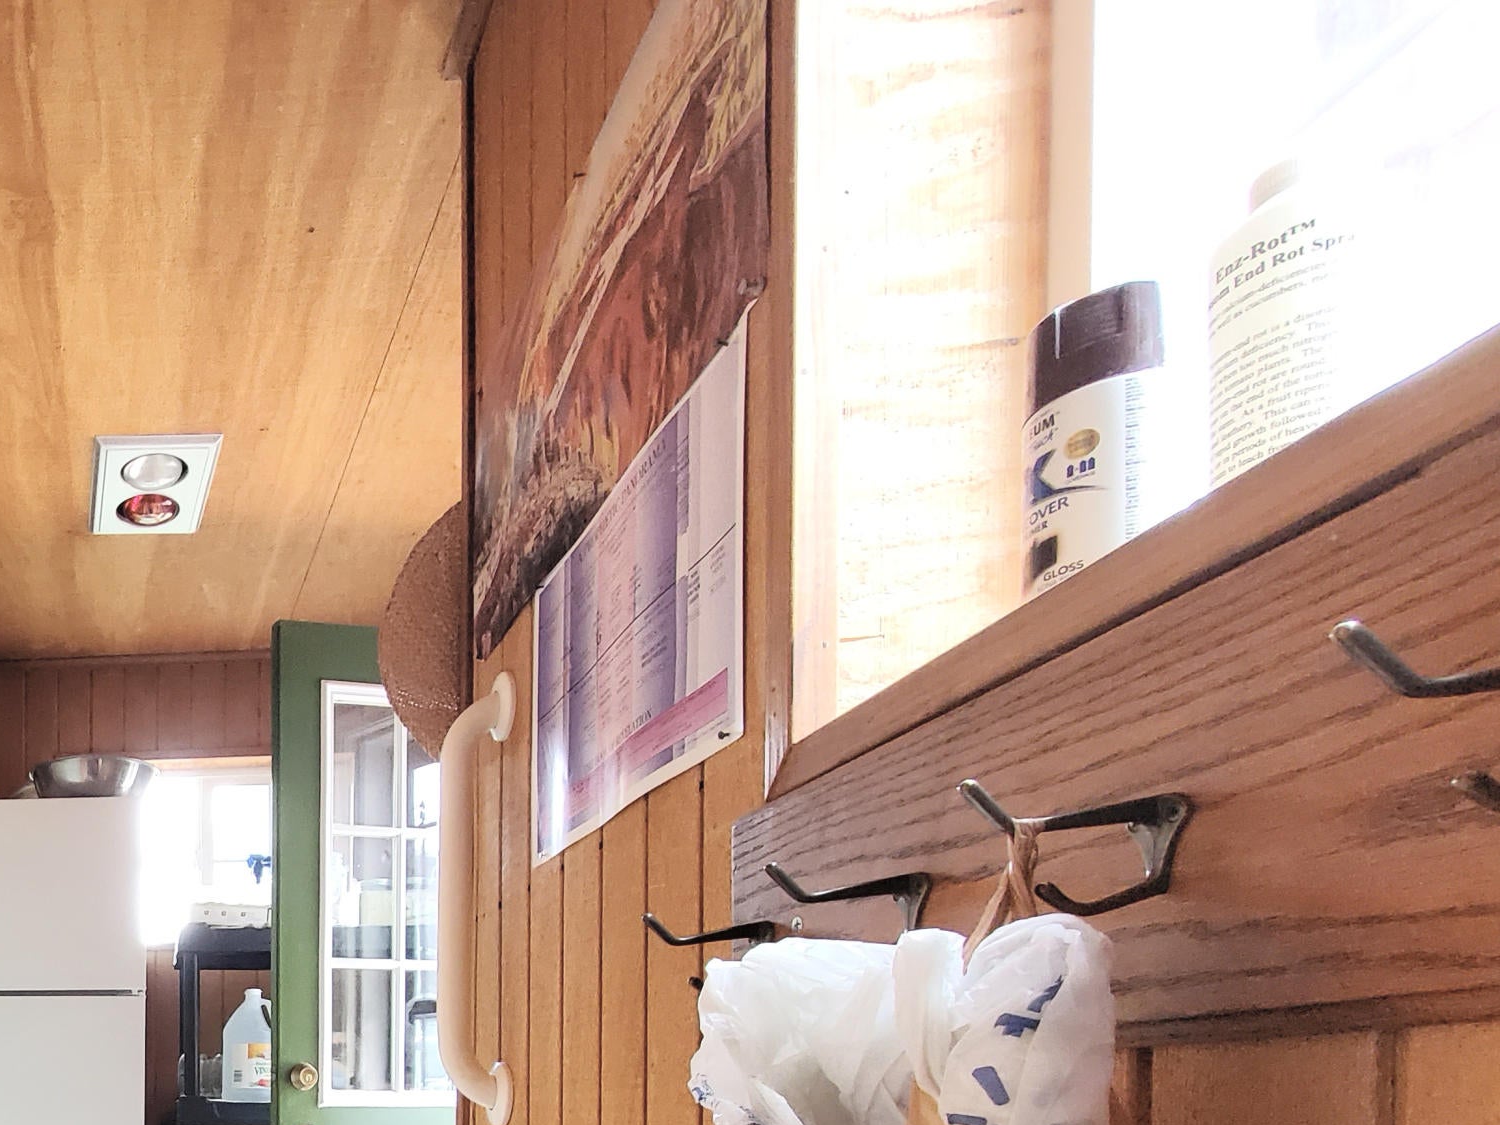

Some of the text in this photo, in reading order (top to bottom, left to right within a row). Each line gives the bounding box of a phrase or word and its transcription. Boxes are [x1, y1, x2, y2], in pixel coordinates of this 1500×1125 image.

[1233, 261, 1266, 289] End
[1272, 245, 1304, 268] Rot
[1043, 559, 1084, 582] GLOSS
